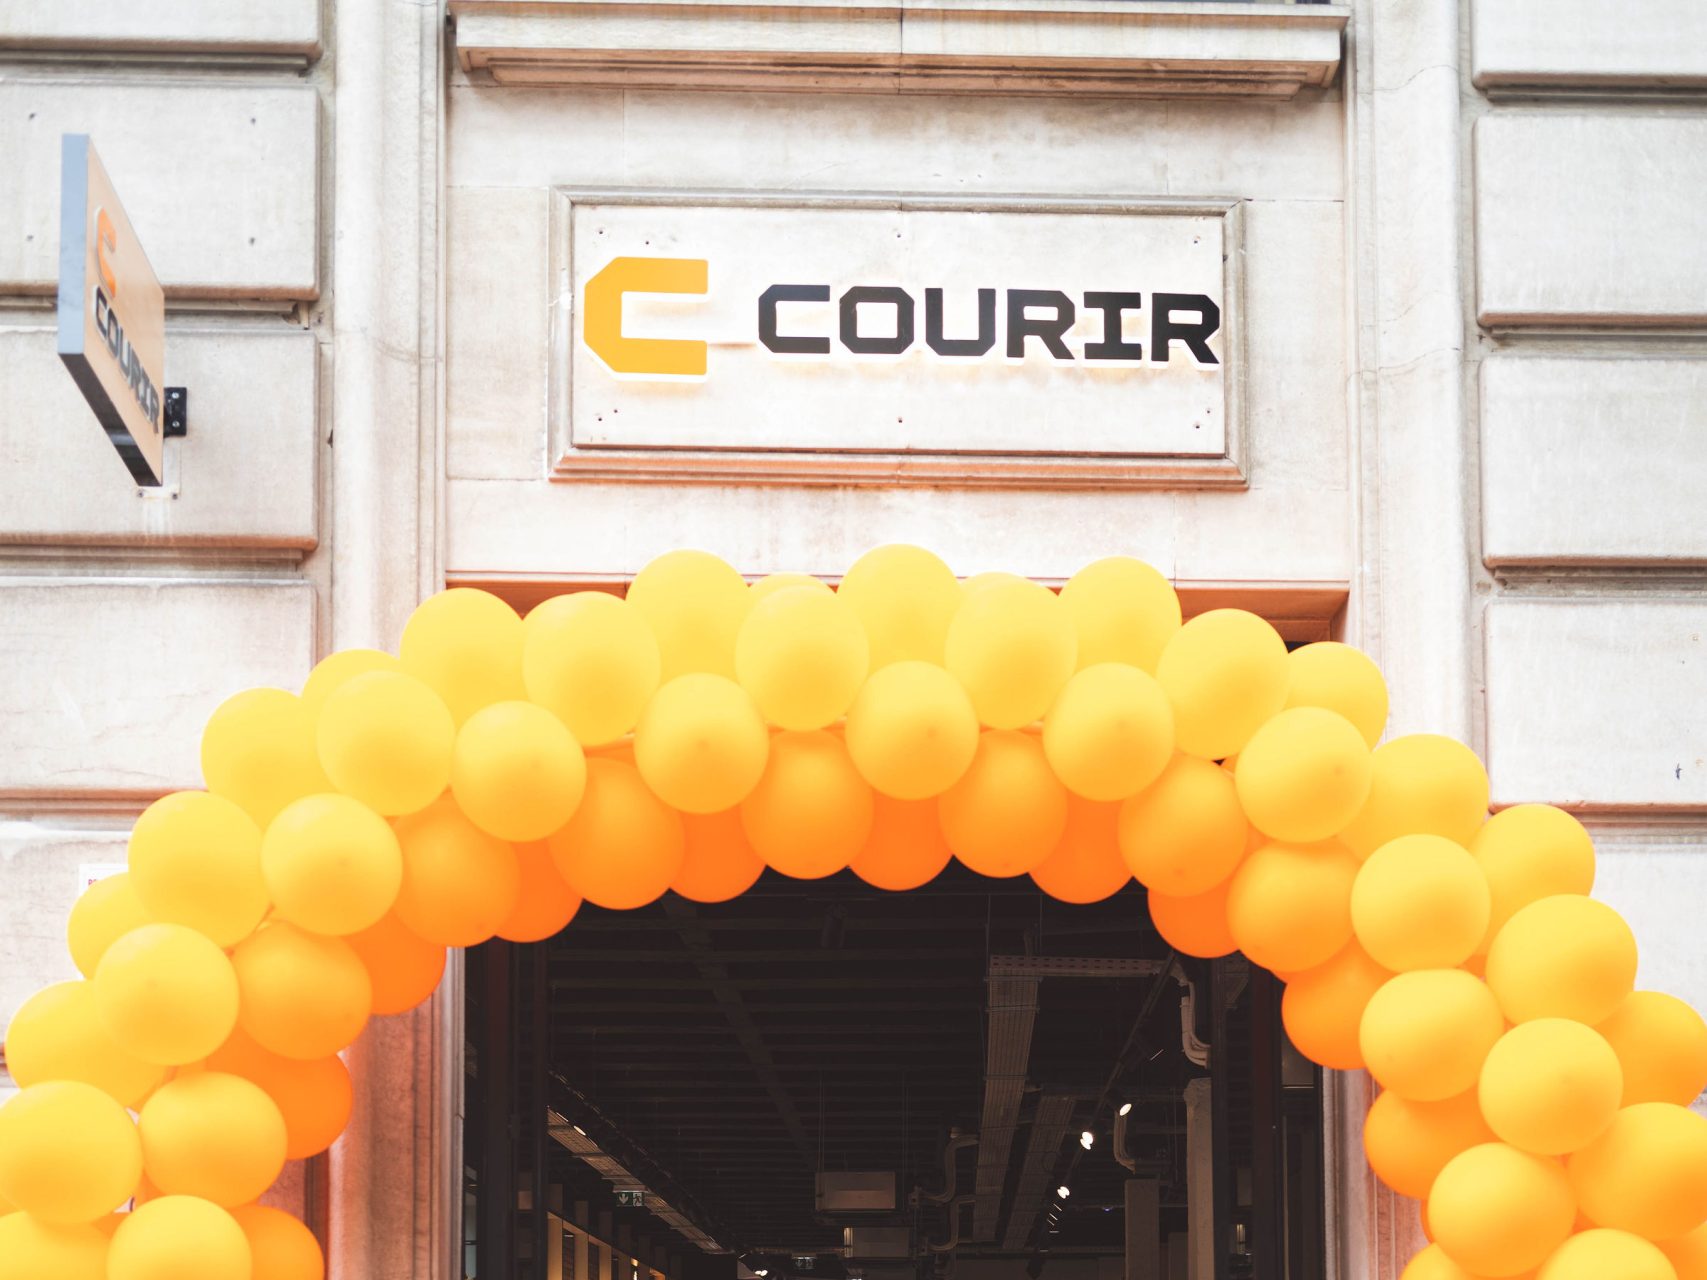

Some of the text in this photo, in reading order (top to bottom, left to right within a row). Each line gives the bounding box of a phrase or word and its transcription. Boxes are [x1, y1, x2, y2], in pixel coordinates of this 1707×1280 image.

[95, 286, 160, 434] COURIR
[584, 256, 1220, 376] C COURIR
